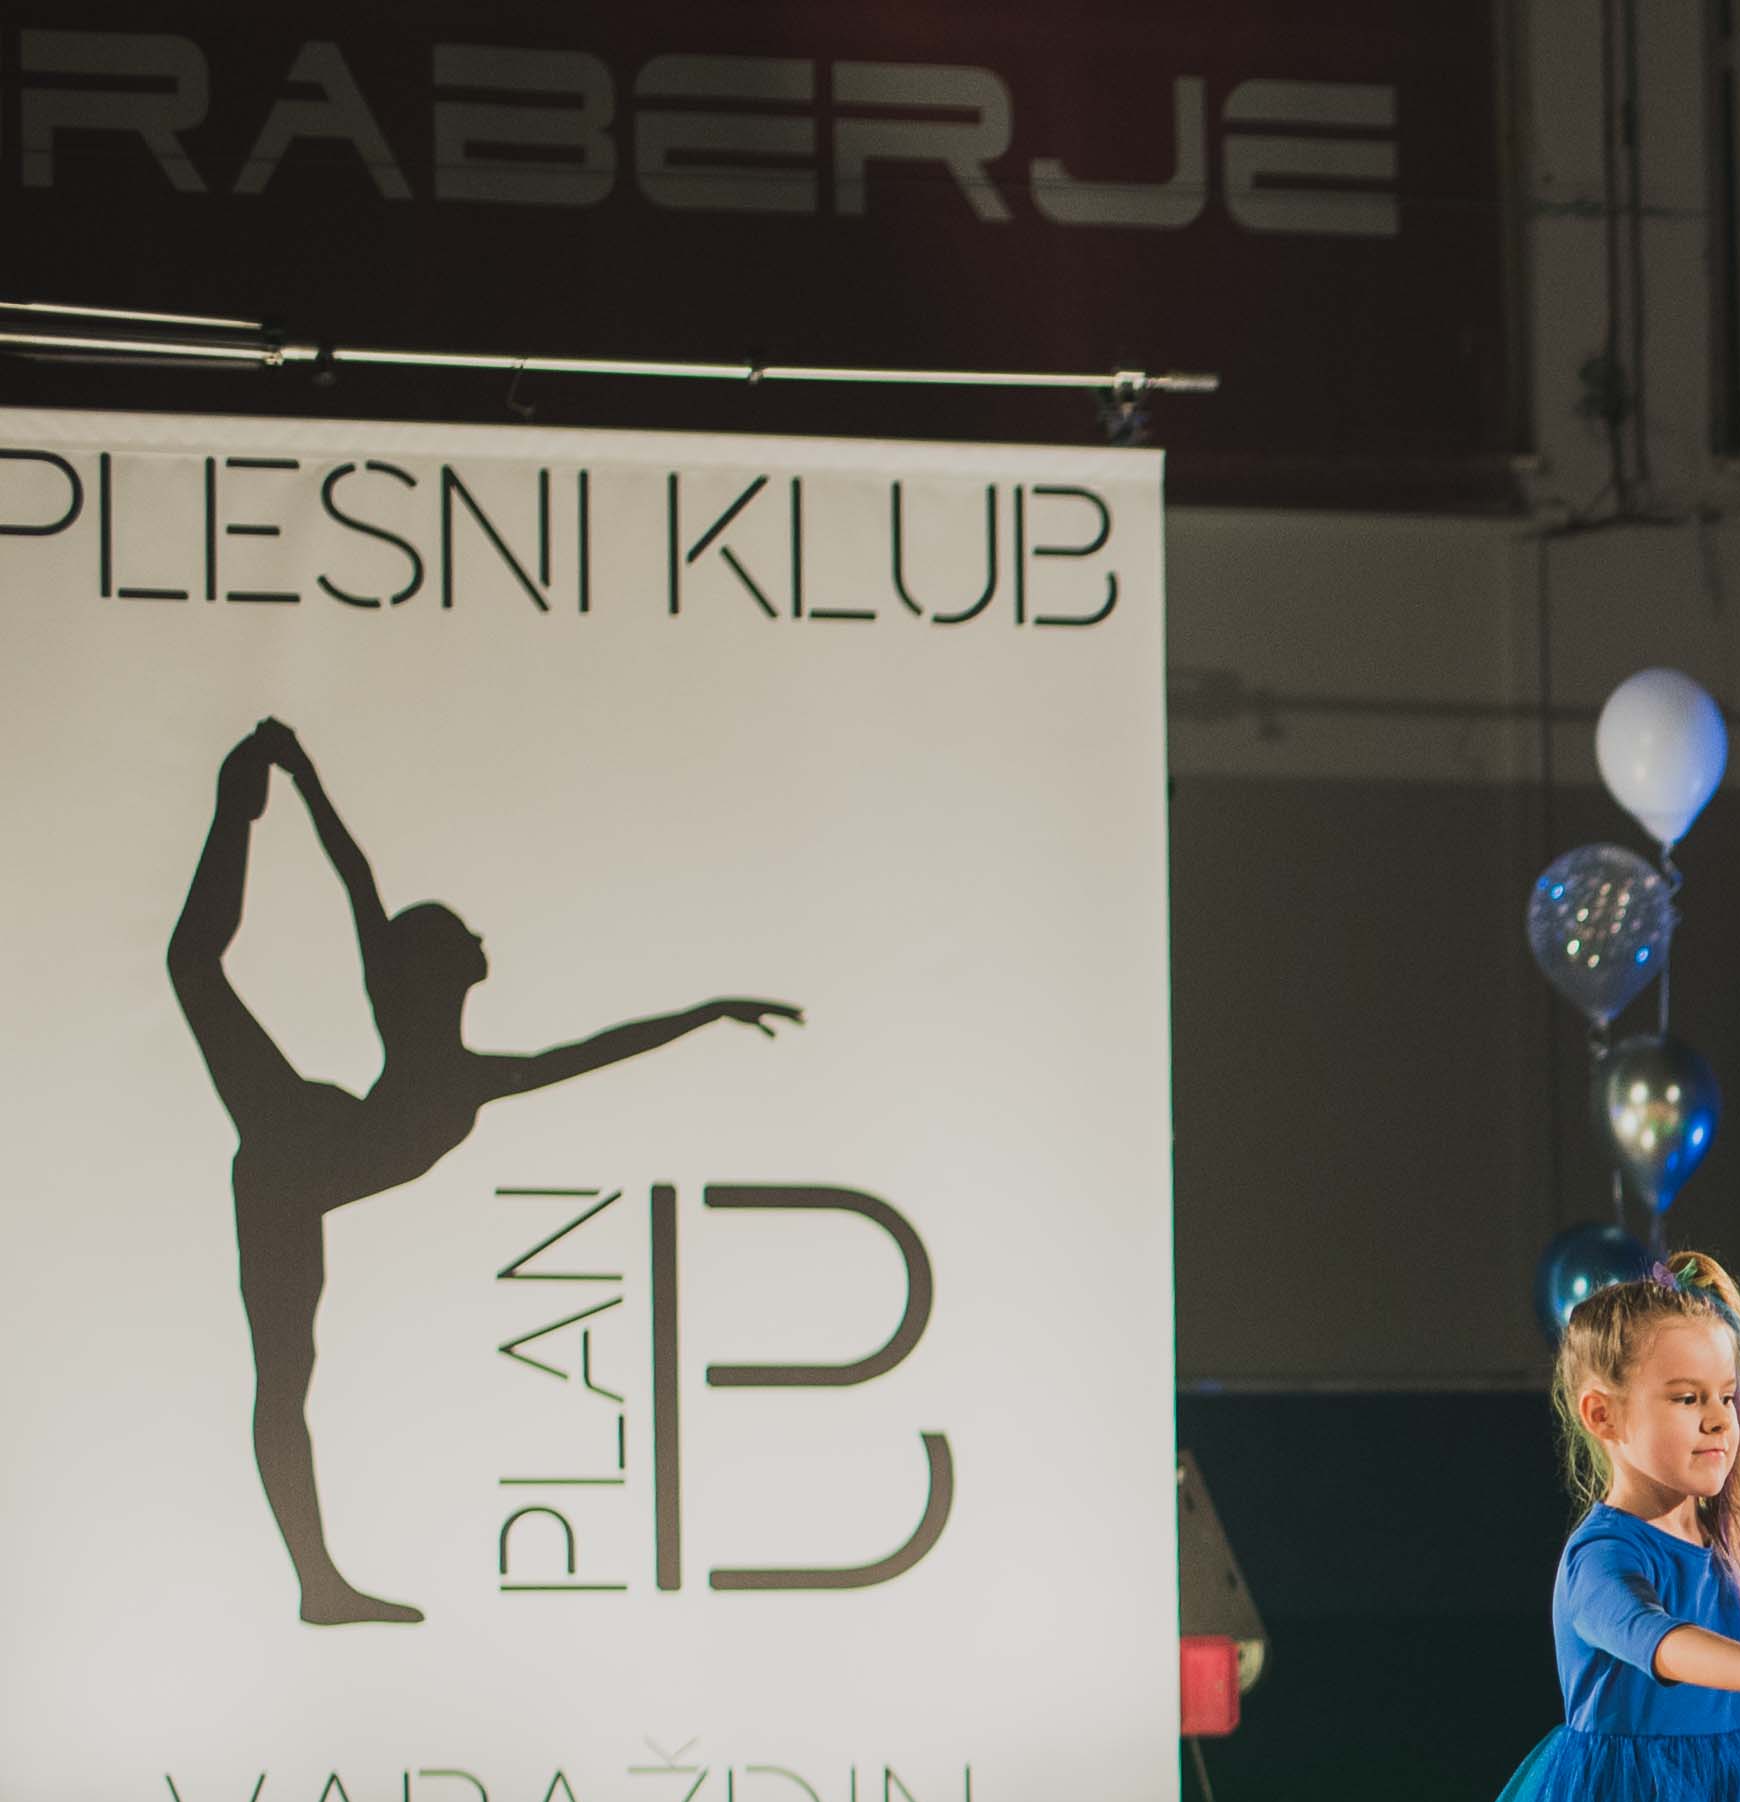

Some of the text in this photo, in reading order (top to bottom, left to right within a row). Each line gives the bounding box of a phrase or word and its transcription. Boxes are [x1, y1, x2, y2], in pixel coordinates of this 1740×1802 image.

[0, 29, 1399, 236] RABERJE
[0, 448, 1120, 627] PLESNI KLUB
[494, 1186, 627, 1592] PLAN
[650, 1182, 955, 1592] B
